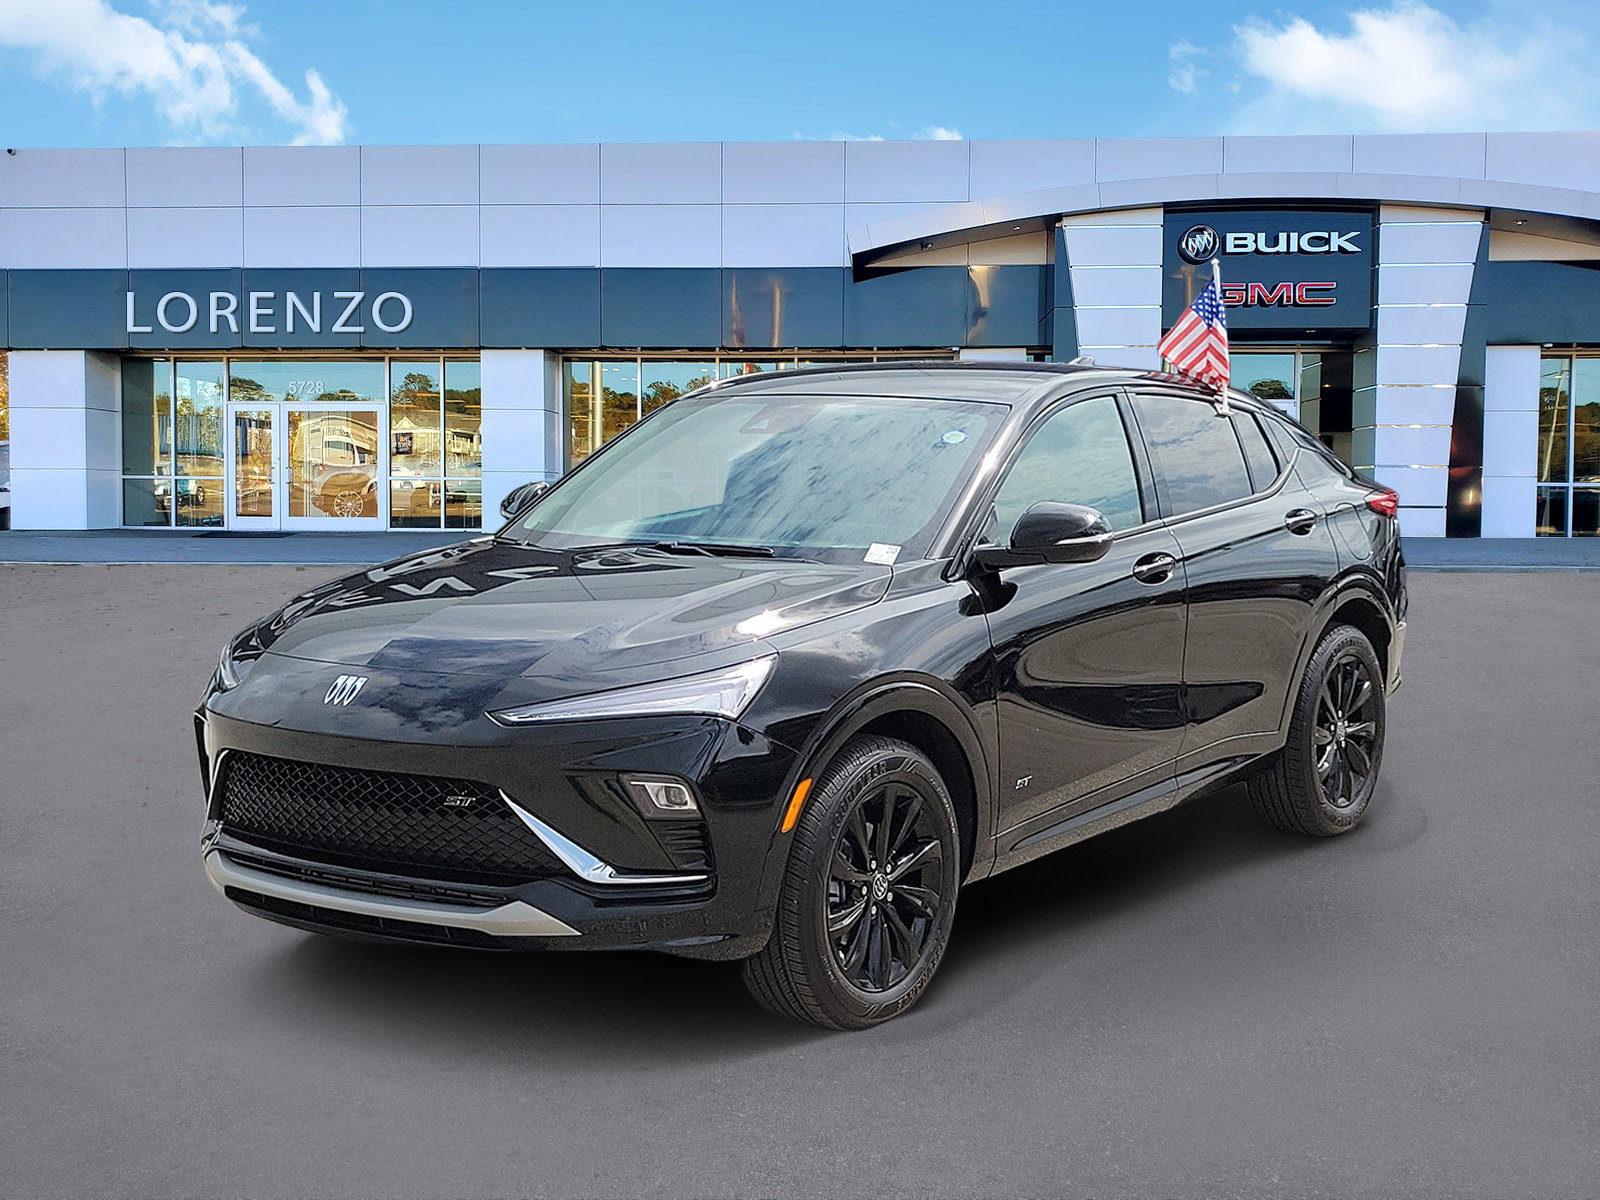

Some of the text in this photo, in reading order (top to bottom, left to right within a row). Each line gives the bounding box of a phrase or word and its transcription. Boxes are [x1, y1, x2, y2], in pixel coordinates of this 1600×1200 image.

[1225, 231, 1362, 253] BUICK
[1221, 281, 1337, 305] GMC
[126, 291, 414, 333] LORENZO
[288, 381, 325, 394] 5728
[443, 795, 476, 806] ST
